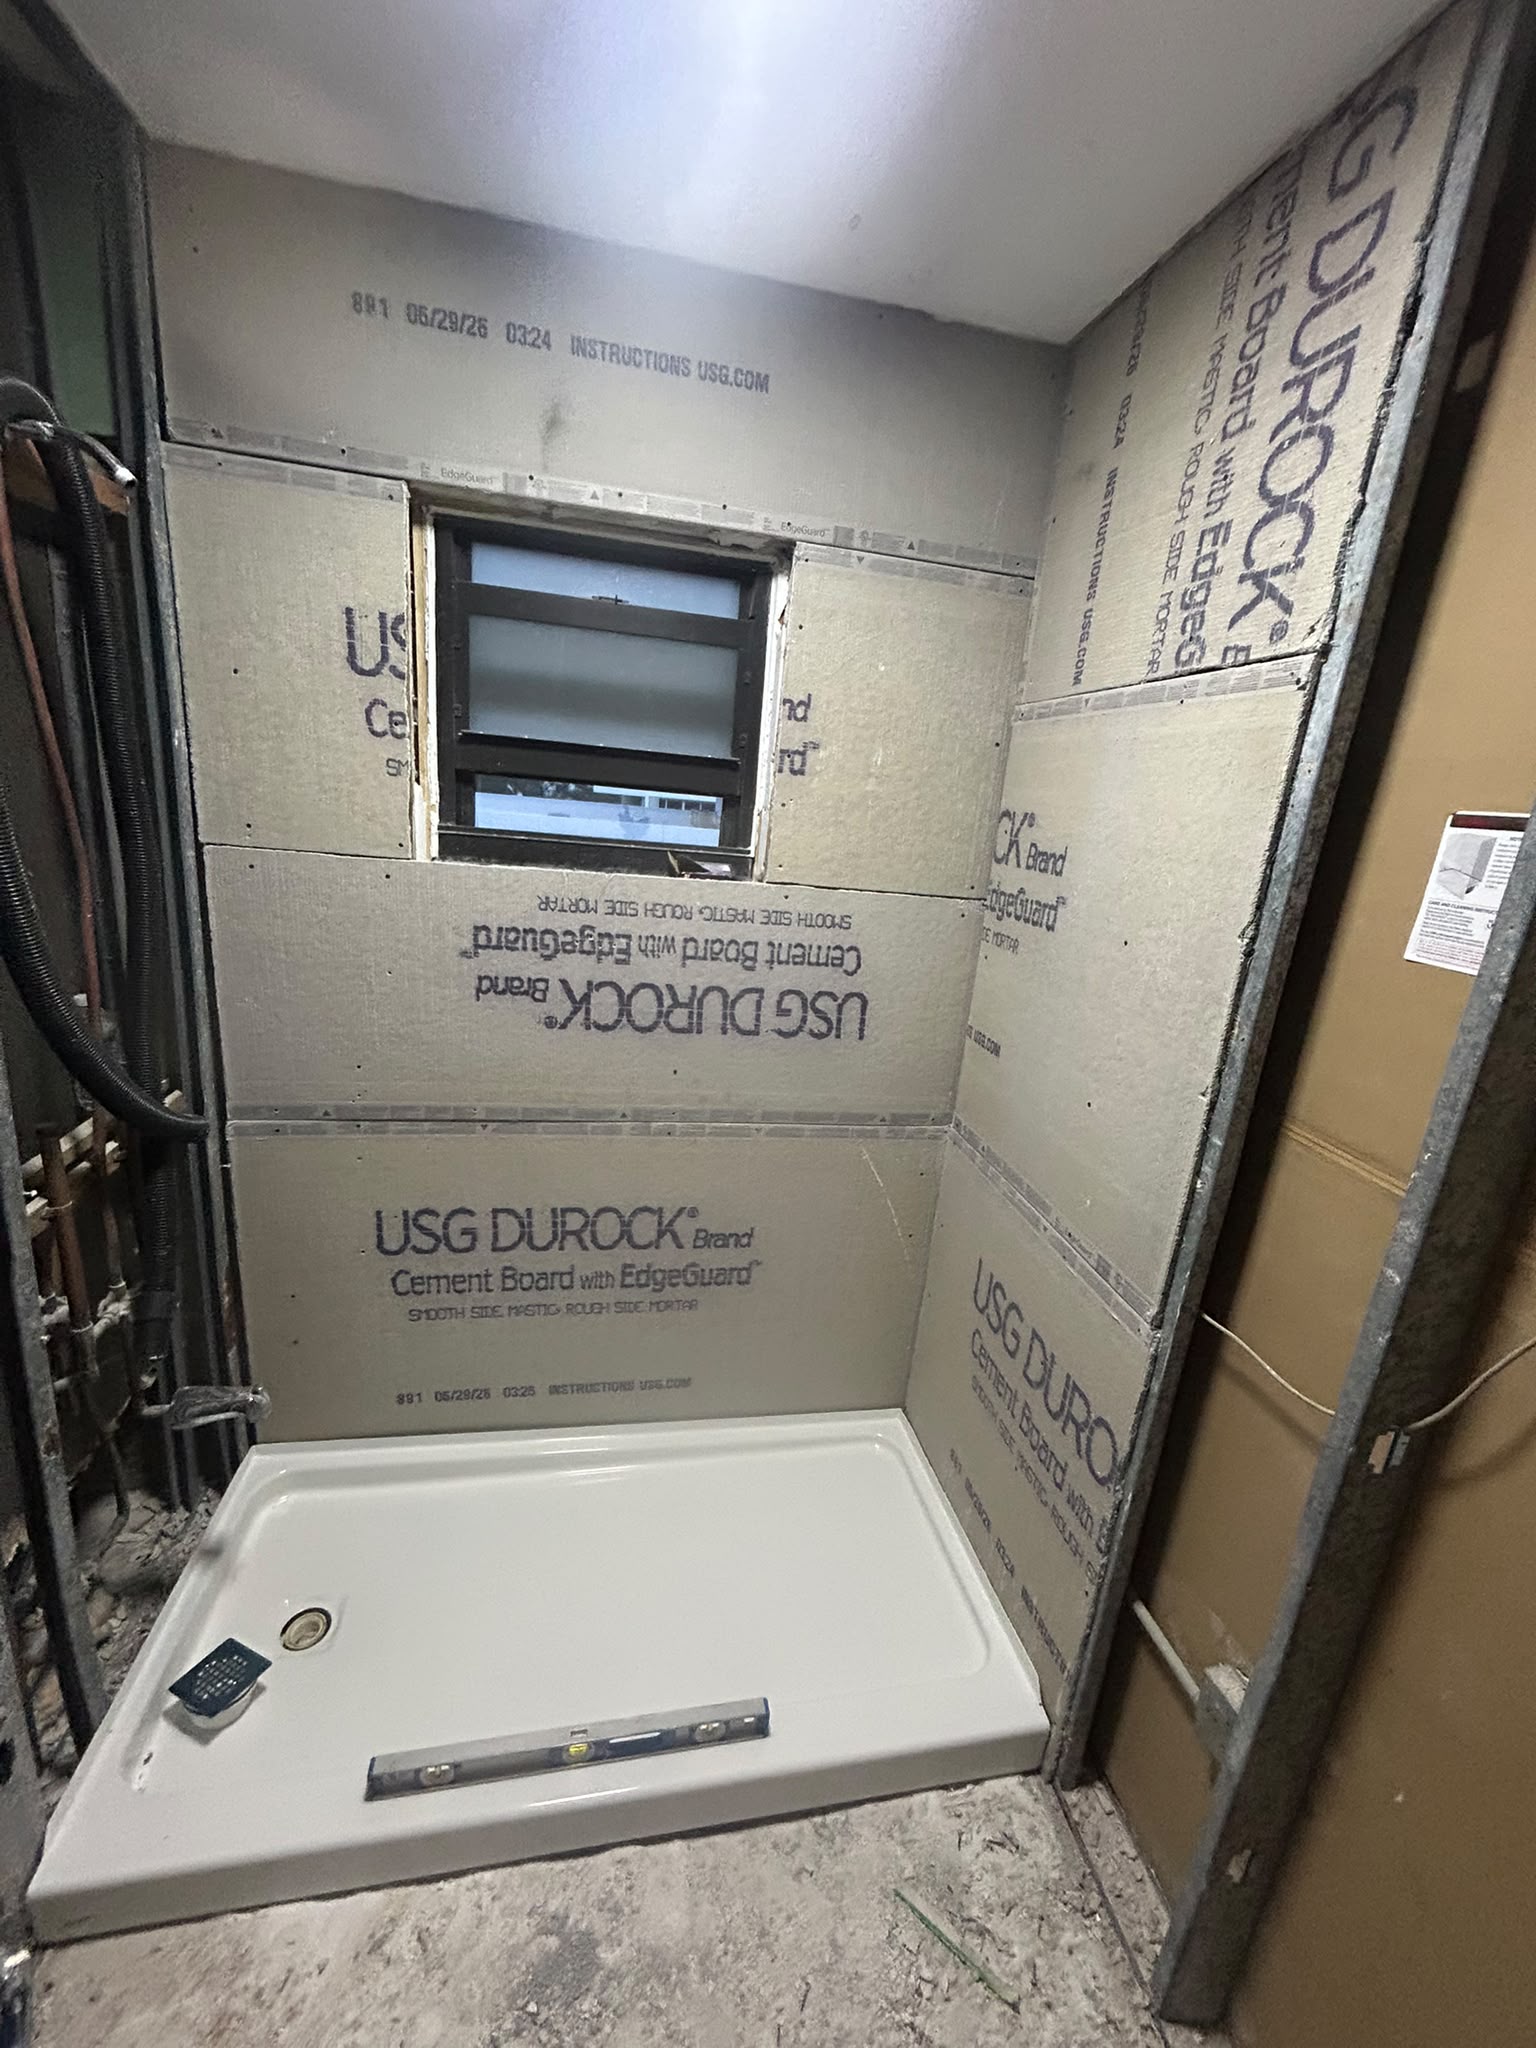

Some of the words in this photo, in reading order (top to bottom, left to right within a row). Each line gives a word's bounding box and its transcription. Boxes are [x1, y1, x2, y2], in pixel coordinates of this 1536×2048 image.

[1216, 263, 1242, 330] SIDE
[570, 334, 692, 378] INSTRUCTIONS
[697, 360, 770, 394] USG.COM
[1221, 281, 1288, 443] Board
[1173, 440, 1205, 526] ROUGH
[1203, 446, 1236, 519] with
[1087, 466, 1118, 602] INSTRUCTIONS
[1162, 529, 1186, 585] SIDE
[1072, 607, 1093, 687] USG.COM
[1146, 589, 1174, 677] MORTAR
[1024, 841, 1069, 878] Brand
[537, 894, 598, 916] MORTAR
[604, 899, 640, 917] SIDE
[643, 902, 694, 920] ROUGH
[760, 908, 793, 927] SIDE
[798, 911, 853, 929] SMOOTH
[637, 933, 678, 955] with
[682, 934, 759, 972] Board
[765, 941, 863, 977] Cement
[475, 974, 550, 1003] Brand
[774, 988, 870, 1042] USG
[374, 1206, 478, 1257] USG
[692, 1226, 755, 1251] Brand
[391, 1266, 495, 1298] Cement
[499, 1263, 576, 1293] Board
[578, 1267, 617, 1291] with
[407, 1305, 466, 1322] SMOOTH
[469, 1303, 503, 1319] SIDE
[564, 1300, 611, 1316] ROUGH
[613, 1299, 646, 1315] SIDE
[648, 1298, 699, 1314] MORTAR
[971, 1257, 1026, 1361] USG
[547, 1378, 636, 1397] INSTRUCTIONS
[969, 1327, 1019, 1420] Cement
[1018, 1399, 1069, 1492] Board
[1066, 1482, 1094, 1540] with
